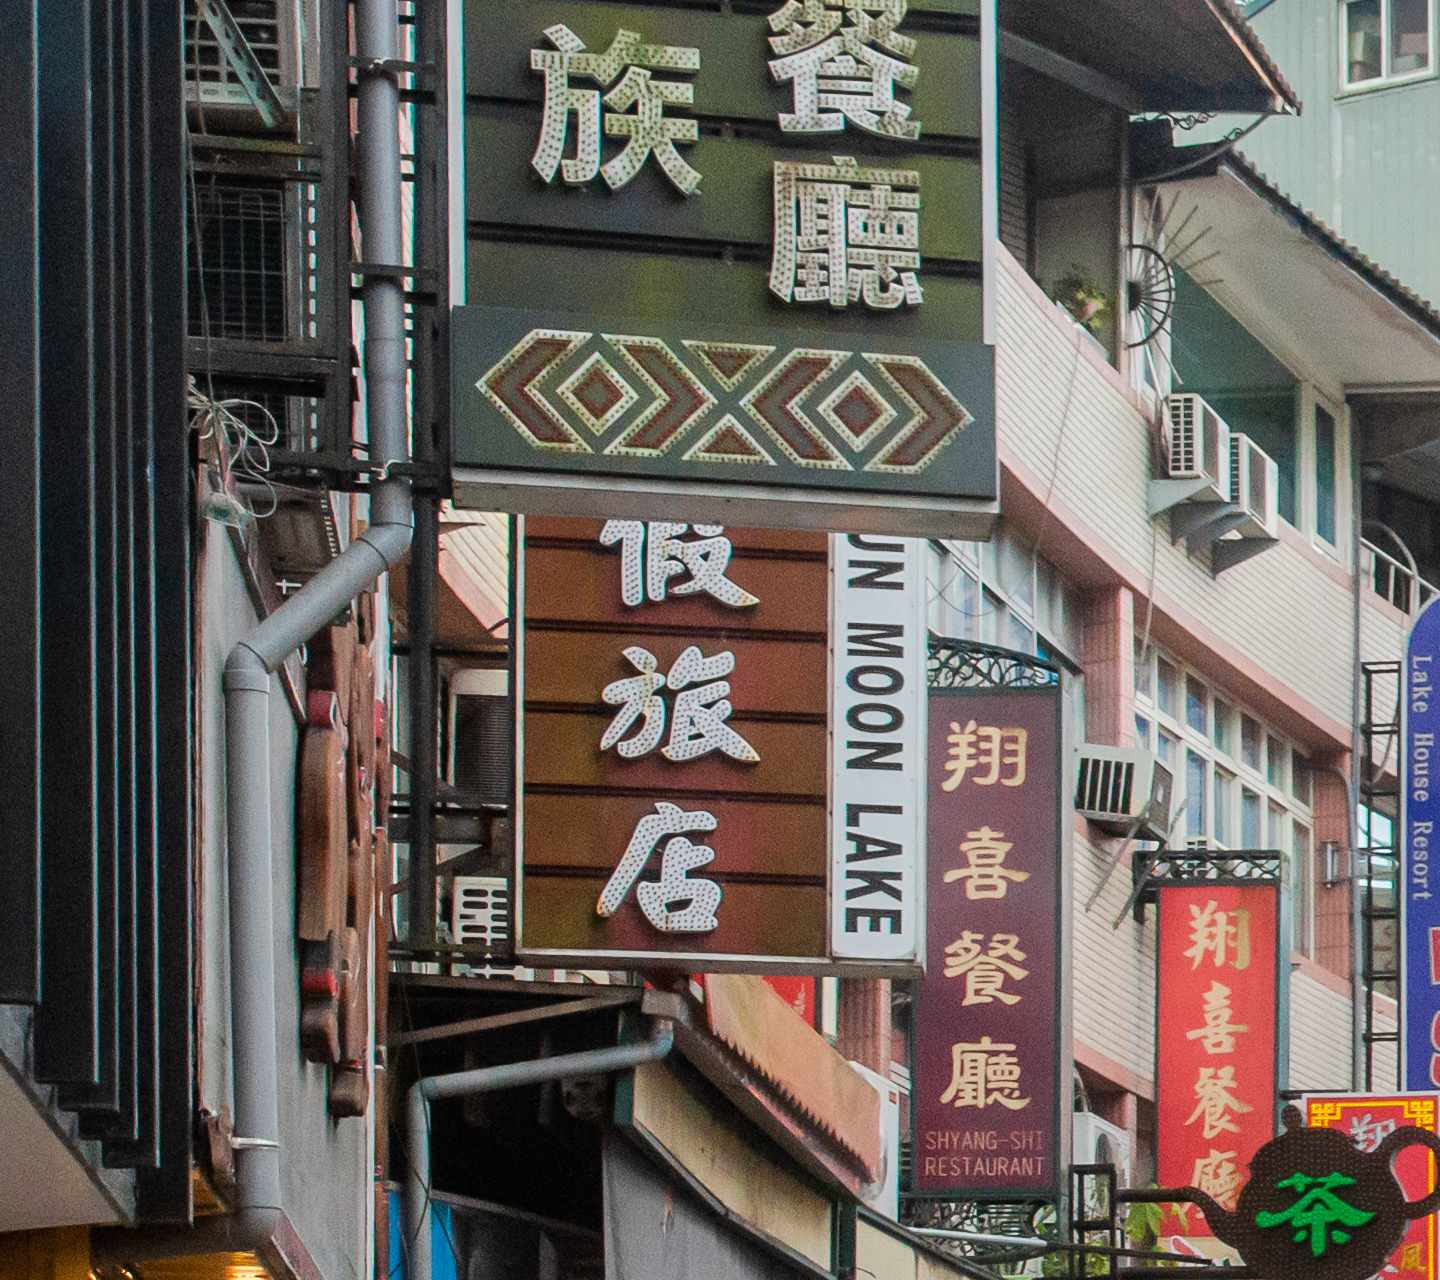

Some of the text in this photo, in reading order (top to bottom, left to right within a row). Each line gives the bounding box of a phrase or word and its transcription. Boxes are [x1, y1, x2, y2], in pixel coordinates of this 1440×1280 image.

[844, 623, 905, 934] MOON LAKE
[1411, 656, 1431, 902] Lake House Resort
[940, 720, 1030, 1111] 翔喜餐廳
[925, 1130, 1044, 1152] SHYANG-SHI
[925, 1156, 1045, 1177] RESTAURANT
[1256, 1173, 1376, 1256] 茶
